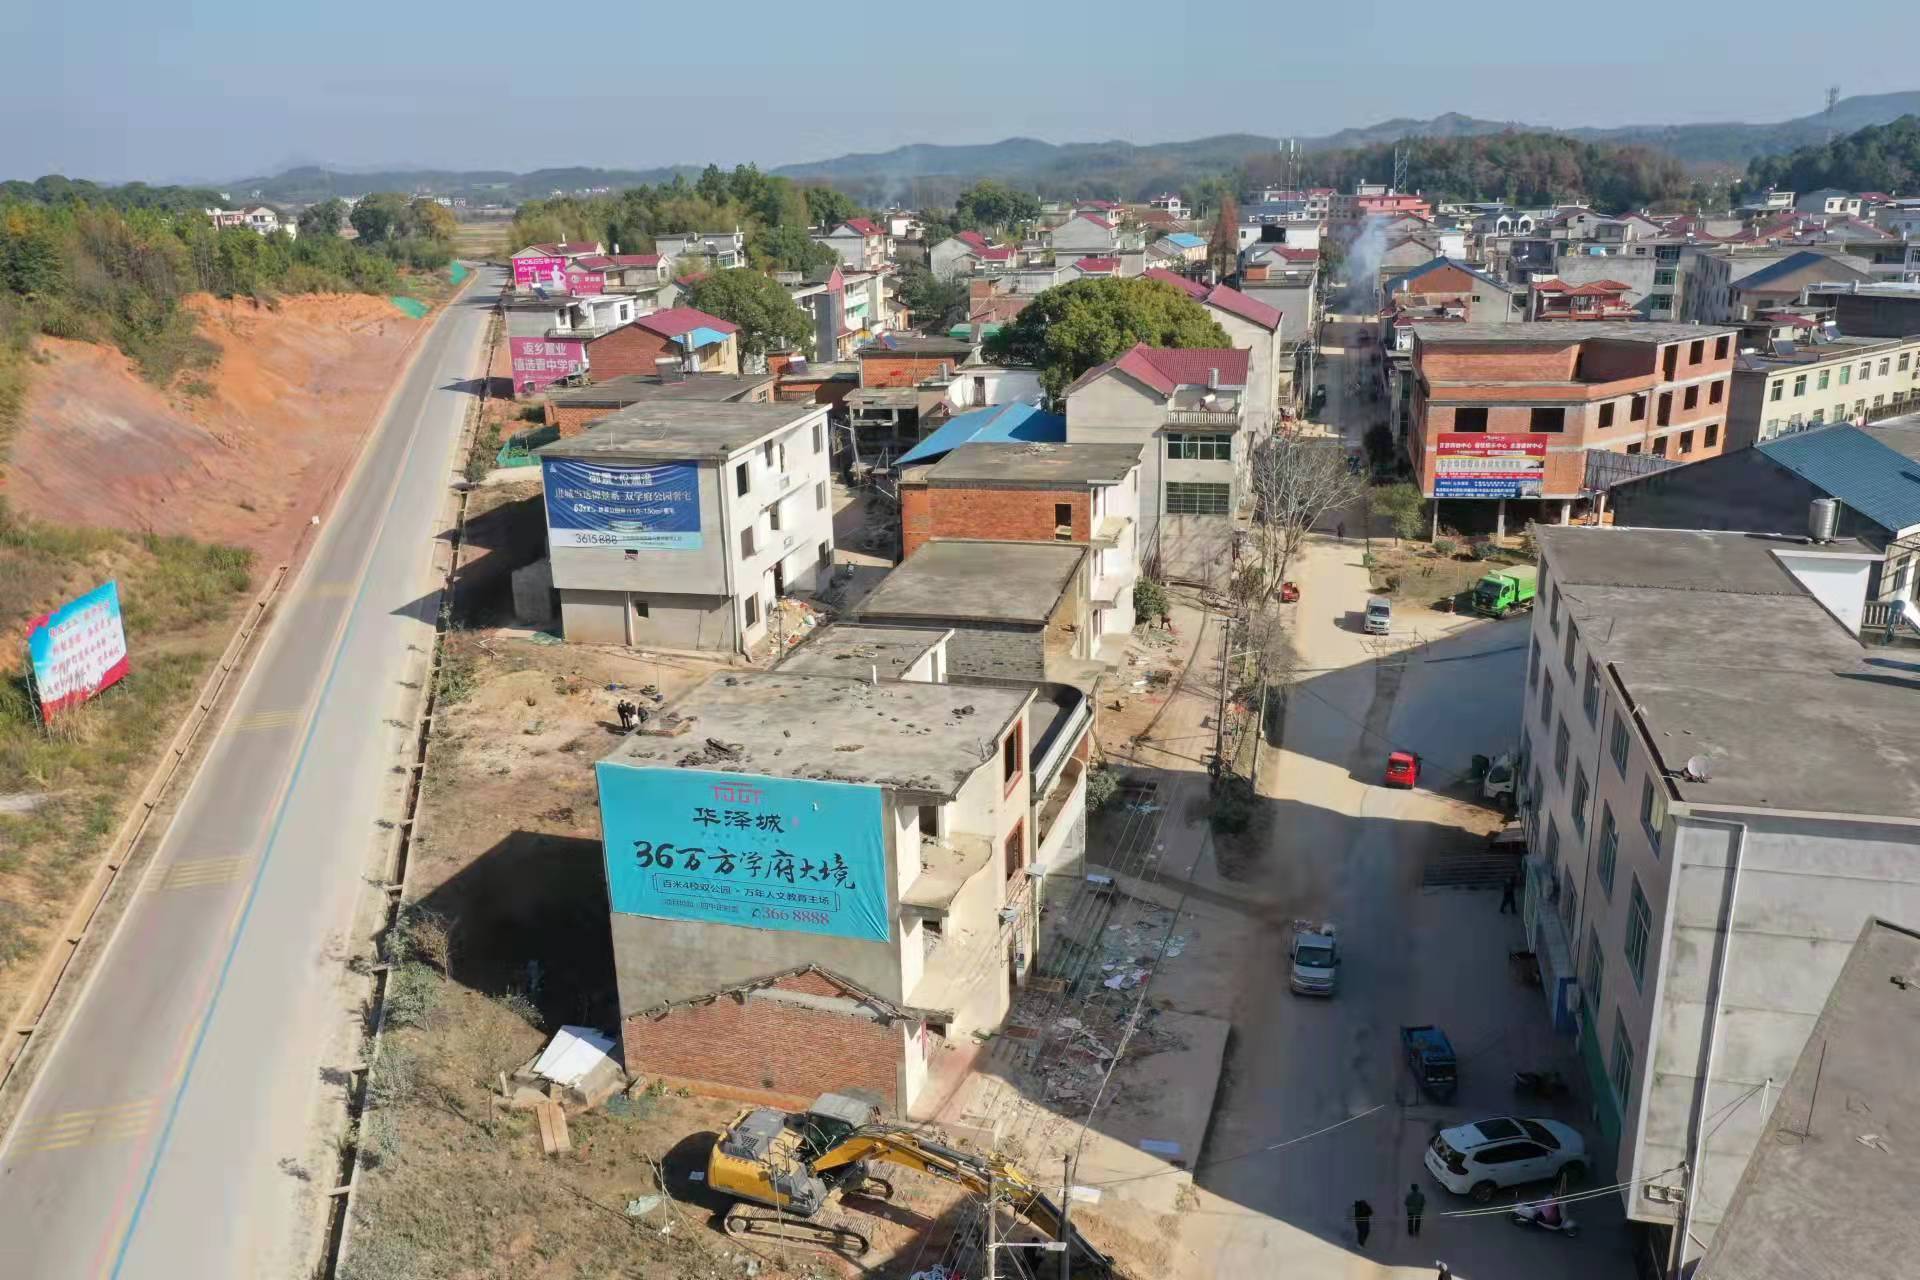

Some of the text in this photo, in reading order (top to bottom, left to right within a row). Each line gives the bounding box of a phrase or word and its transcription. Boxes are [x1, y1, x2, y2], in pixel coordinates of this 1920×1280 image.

[576, 533, 618, 545] 3615888
[693, 807, 785, 834] 华泽城
[632, 840, 857, 890] 36万方学府大境
